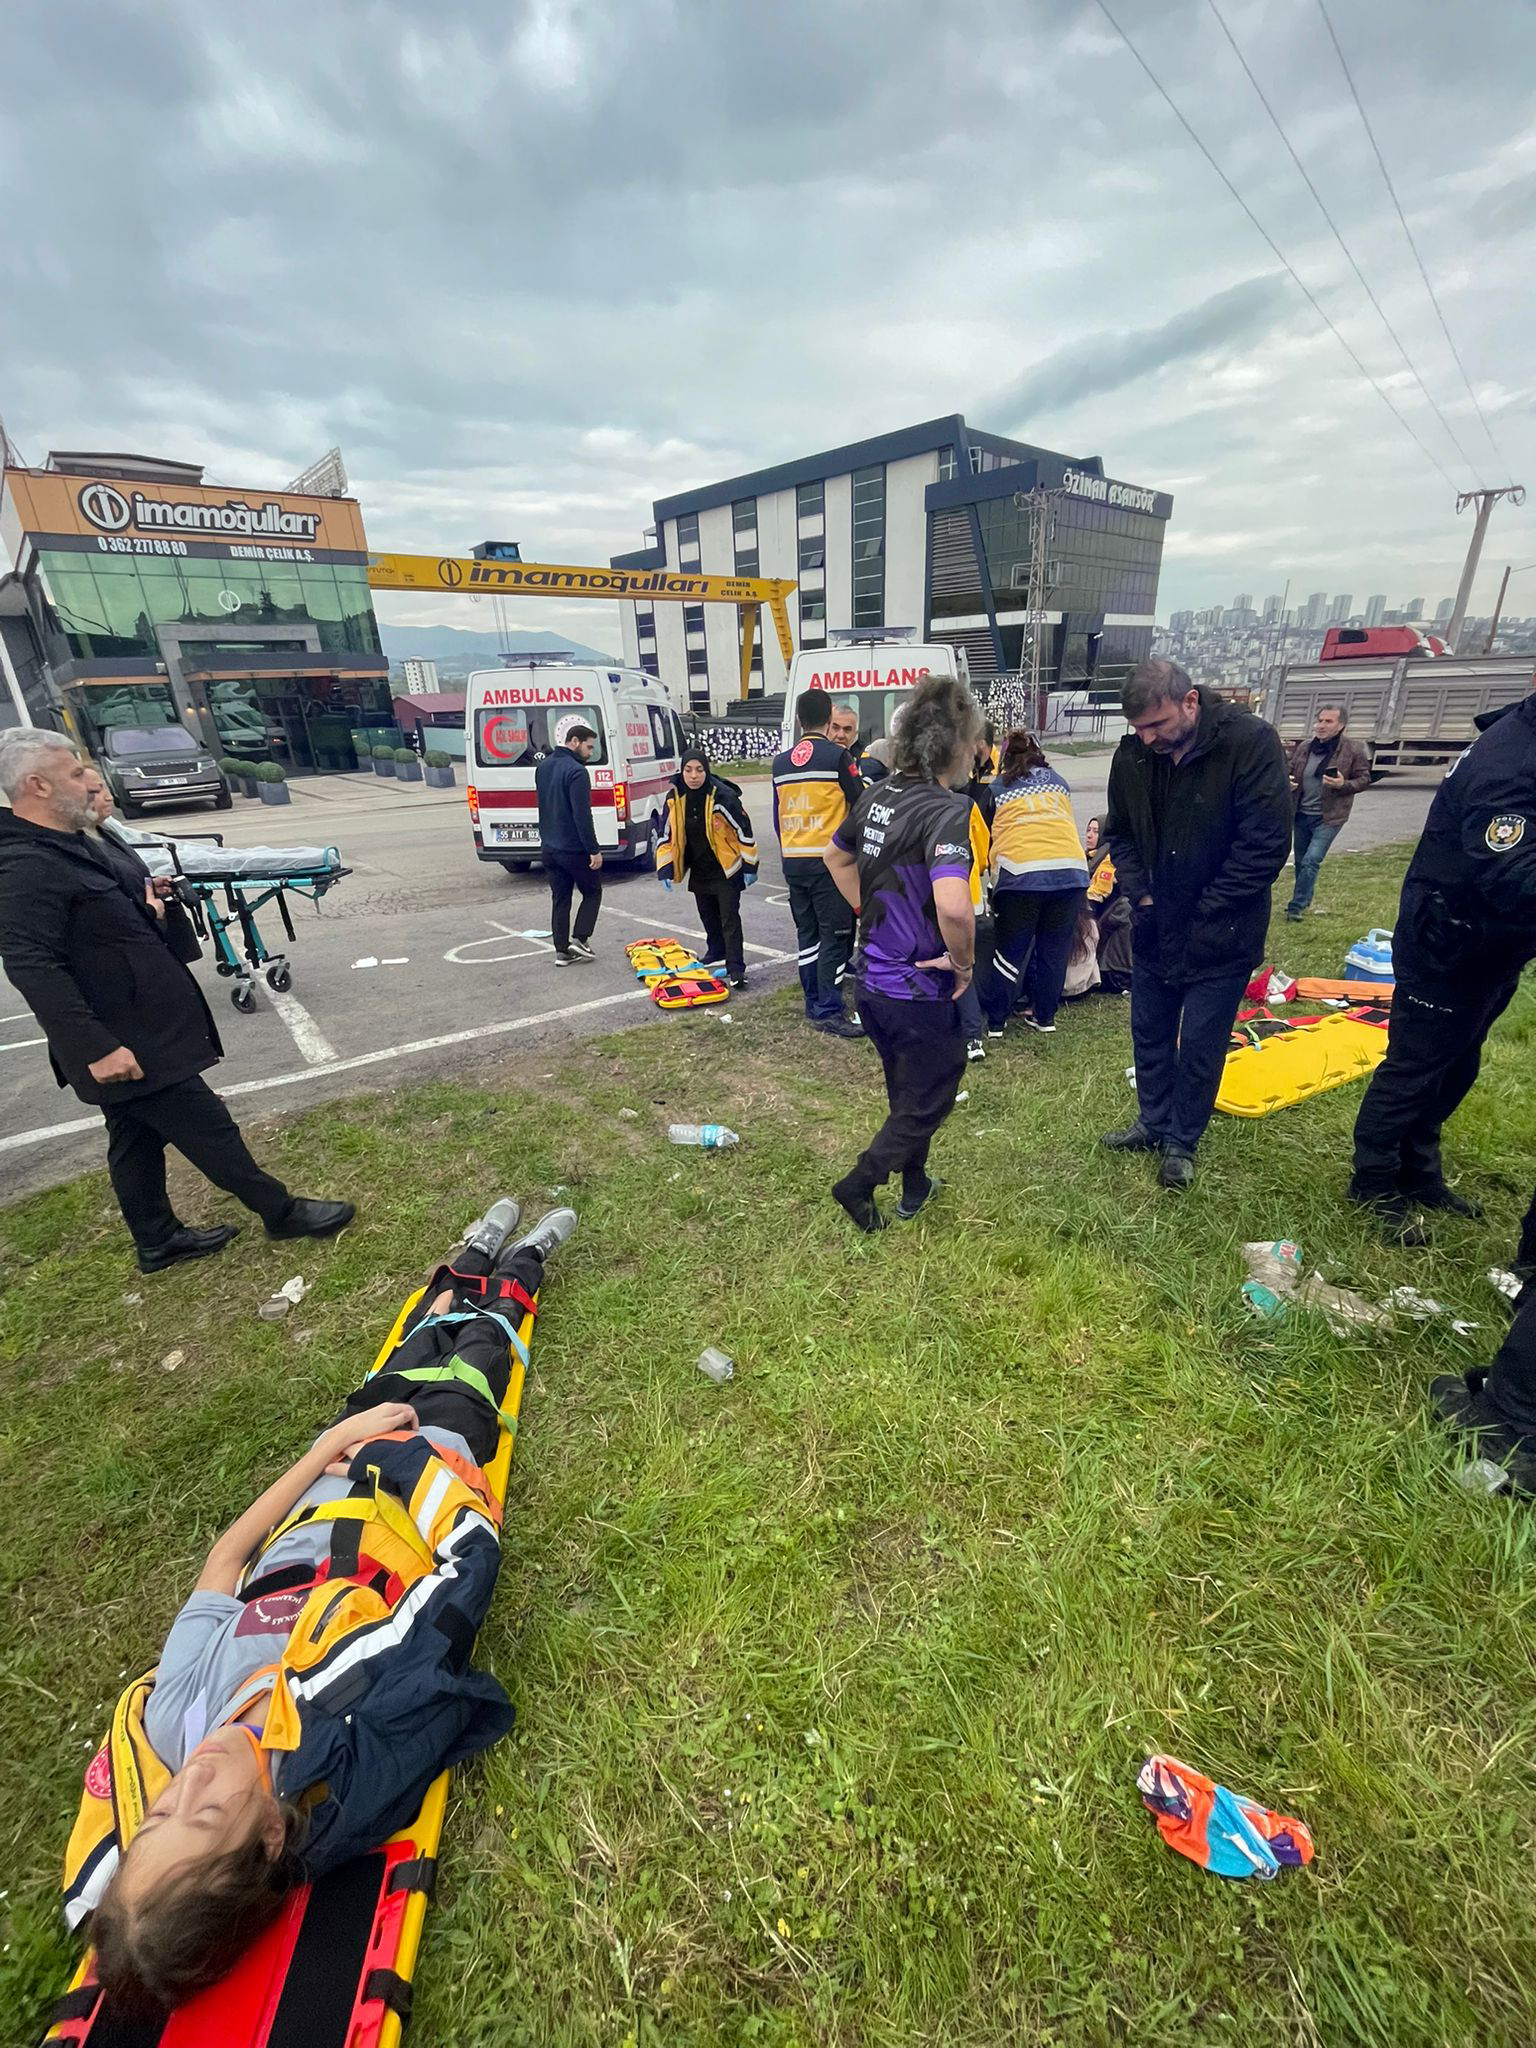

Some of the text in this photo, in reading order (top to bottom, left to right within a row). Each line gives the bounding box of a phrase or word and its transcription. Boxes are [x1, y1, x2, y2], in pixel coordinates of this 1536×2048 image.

[1108, 485, 1154, 513] ASANSÖR
[136, 494, 315, 535] imamoğulları
[108, 537, 132, 552] 362
[230, 545, 265, 560] DEMİR
[266, 546, 295, 562] ÇELİK
[470, 562, 709, 592] imamoğulları
[483, 687, 584, 705] AMBULANS
[596, 771, 612, 781] 112
[867, 802, 895, 826] FSMC
